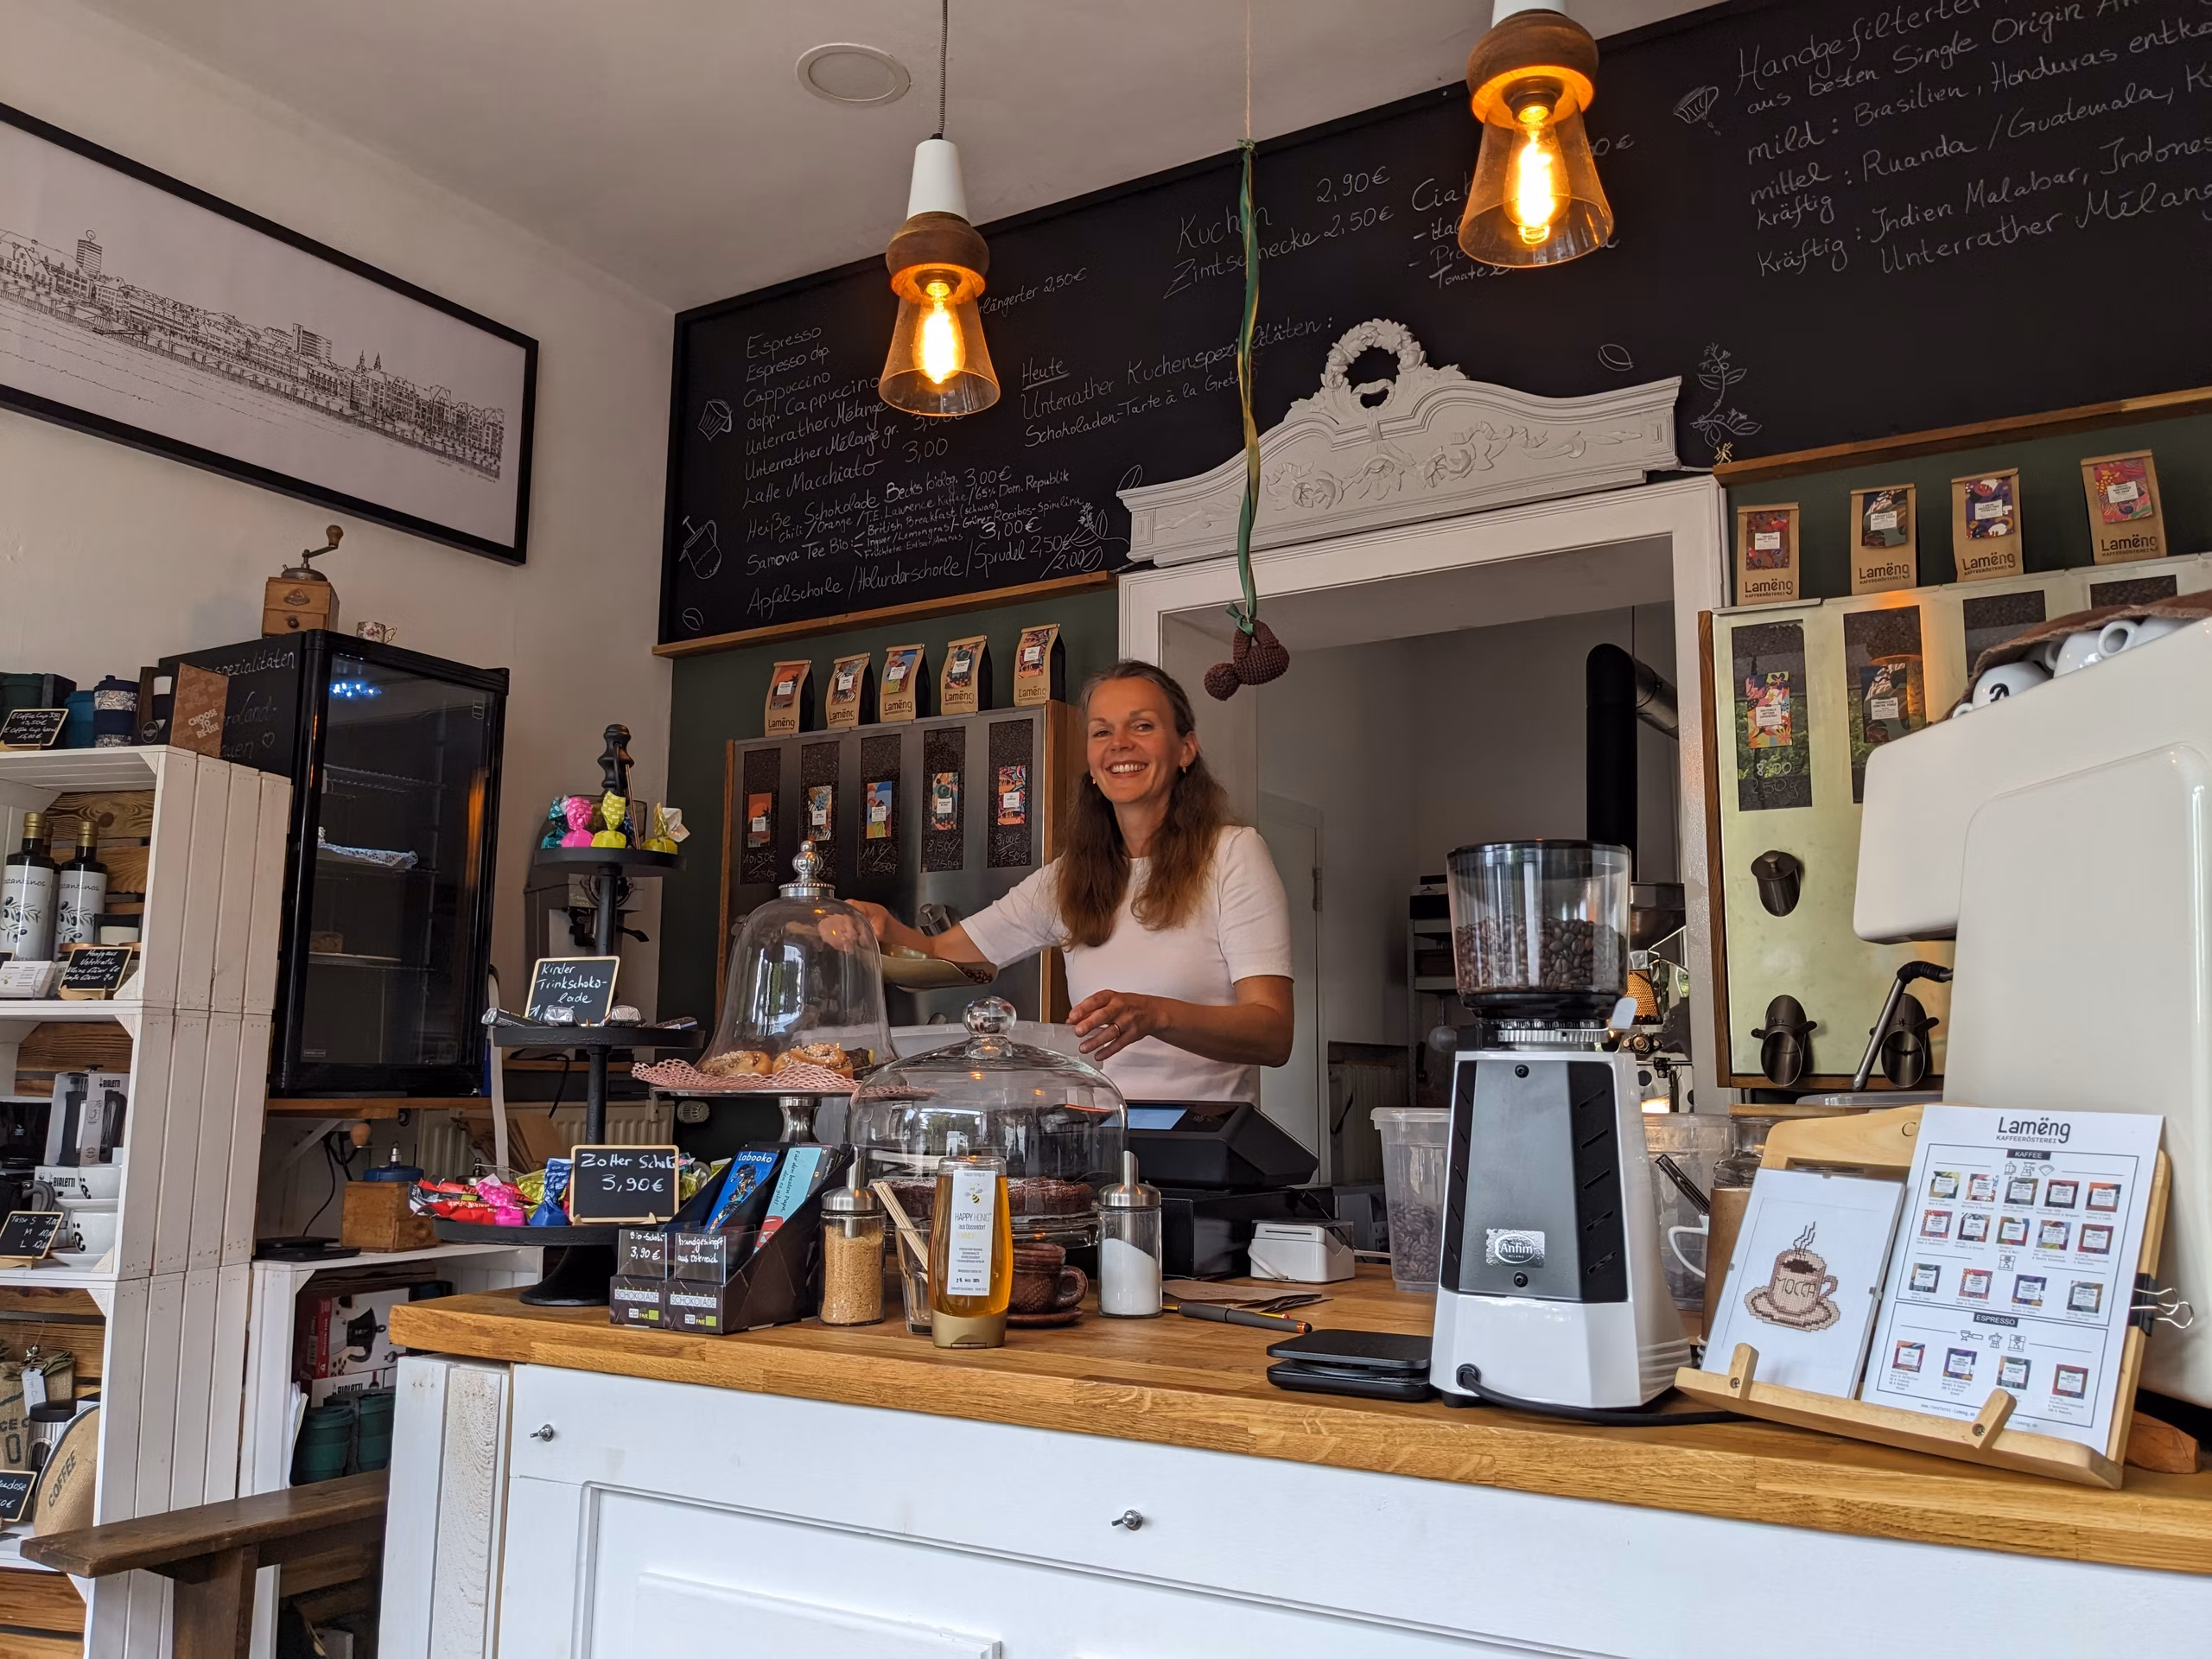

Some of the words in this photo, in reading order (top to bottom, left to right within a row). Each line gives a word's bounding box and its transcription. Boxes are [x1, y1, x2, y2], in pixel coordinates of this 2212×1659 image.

[1746, 92, 1790, 115] aus
[1808, 67, 1879, 98] besten
[1892, 34, 1979, 74] Single
[1747, 121, 1826, 164] mild
[1991, 48, 2118, 93] Honduras
[1750, 162, 1833, 205] mittel
[1863, 135, 1978, 181] Ruanda
[1316, 165, 1391, 205] 2,90€
[1177, 203, 1272, 254] Kuchn
[1871, 202, 1953, 243] Indien
[1164, 225, 1322, 300] Zimtscnecke
[1323, 206, 1395, 239] 2,50€
[1881, 210, 2064, 273] Unterrather
[1043, 267, 1087, 295] 2,50€
[1429, 264, 1488, 289] Tomate
[746, 327, 822, 361] Espresso
[746, 354, 807, 386] Espresso
[1021, 356, 1067, 387] Heute
[743, 372, 830, 416] Cappuccino
[785, 377, 880, 416] Cappuccino
[1020, 377, 1116, 422] Unterrather
[1182, 382, 1200, 399] la
[746, 416, 830, 456] Unterrather
[745, 445, 823, 480] Unterrather
[901, 437, 949, 463] 3,00
[787, 454, 885, 498] Macchiato
[746, 512, 791, 543] Heiße
[804, 488, 880, 524] Schokolade
[964, 466, 1012, 493] 3,00€
[802, 540, 827, 560] Tee
[868, 518, 903, 537] British
[977, 517, 1043, 541] 3,00€
[2101, 533, 2158, 552] Lamëng
[1859, 562, 1910, 581] Lamëng
[1961, 551, 2016, 571] Lamëng
[747, 575, 844, 620] Apfelschorle
[1745, 577, 1794, 595] Lamëng
[541, 963, 575, 976] Kinder
[536, 975, 607, 991] Trinkschoko-
[557, 992, 593, 1004] lade
[1996, 1135, 2057, 1144] KAFFEERÖSTEREI
[1998, 1116, 2071, 1145] Lamëng
[581, 1152, 631, 1168] Zotter
[738, 1150, 773, 1165] Labooko
[2014, 1150, 2043, 1159] KAFFEE
[53, 1176, 76, 1188] BIALETTI
[601, 1174, 664, 1193] 3,90€
[955, 1212, 973, 1222] HAPPY
[19, 1239, 27, 1249] L
[1498, 1243, 1534, 1255] Anfim
[614, 1289, 659, 1303] SCHOKOLADE
[1774, 1277, 1816, 1297] MOCCA
[671, 1295, 716, 1308] SCHOKOLADE
[1975, 1314, 2016, 1326] ESPRESSO
[48, 1449, 78, 1508] COFFEE
